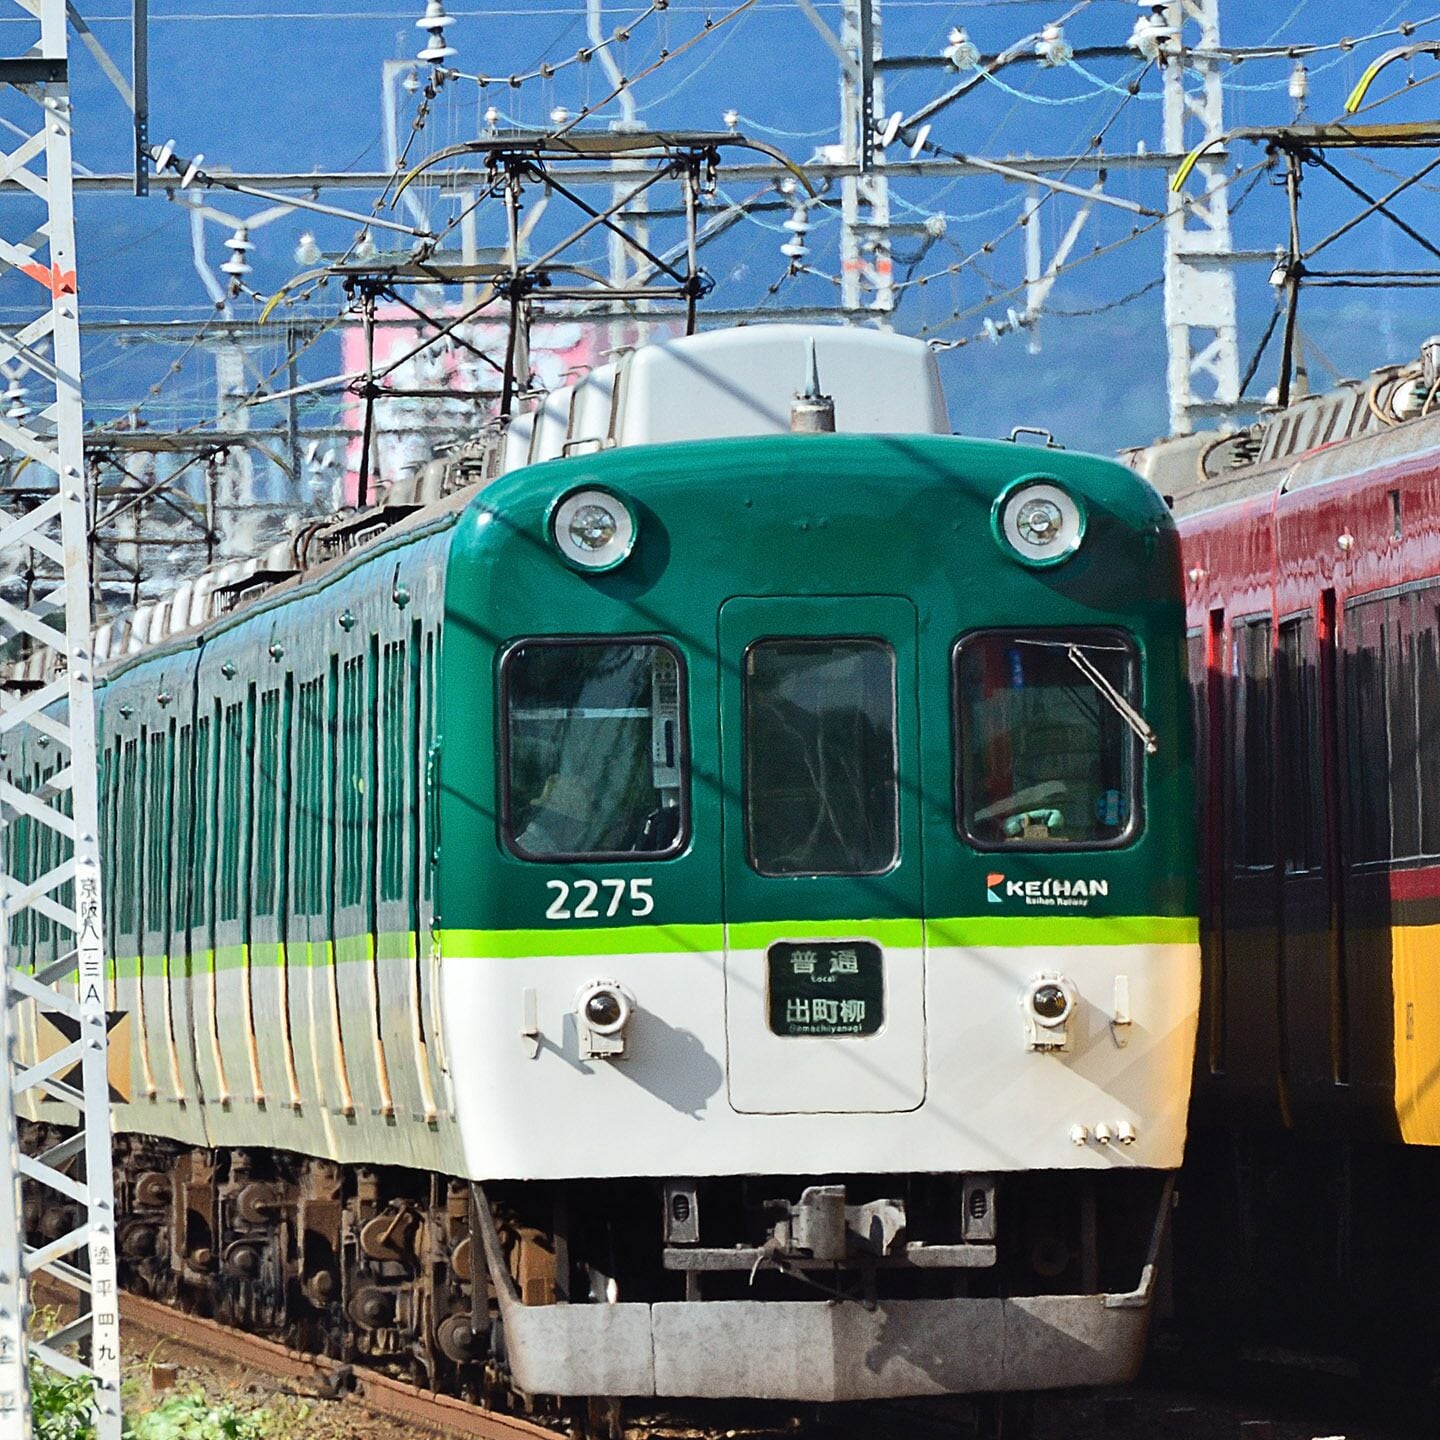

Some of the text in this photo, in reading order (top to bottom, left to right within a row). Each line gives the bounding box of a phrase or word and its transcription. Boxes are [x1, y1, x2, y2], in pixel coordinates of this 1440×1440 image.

[546, 878, 654, 919] 2275
[1006, 878, 1108, 896] KEIHAN
[790, 949, 859, 974] 普通
[786, 998, 866, 1024] 出町柳
